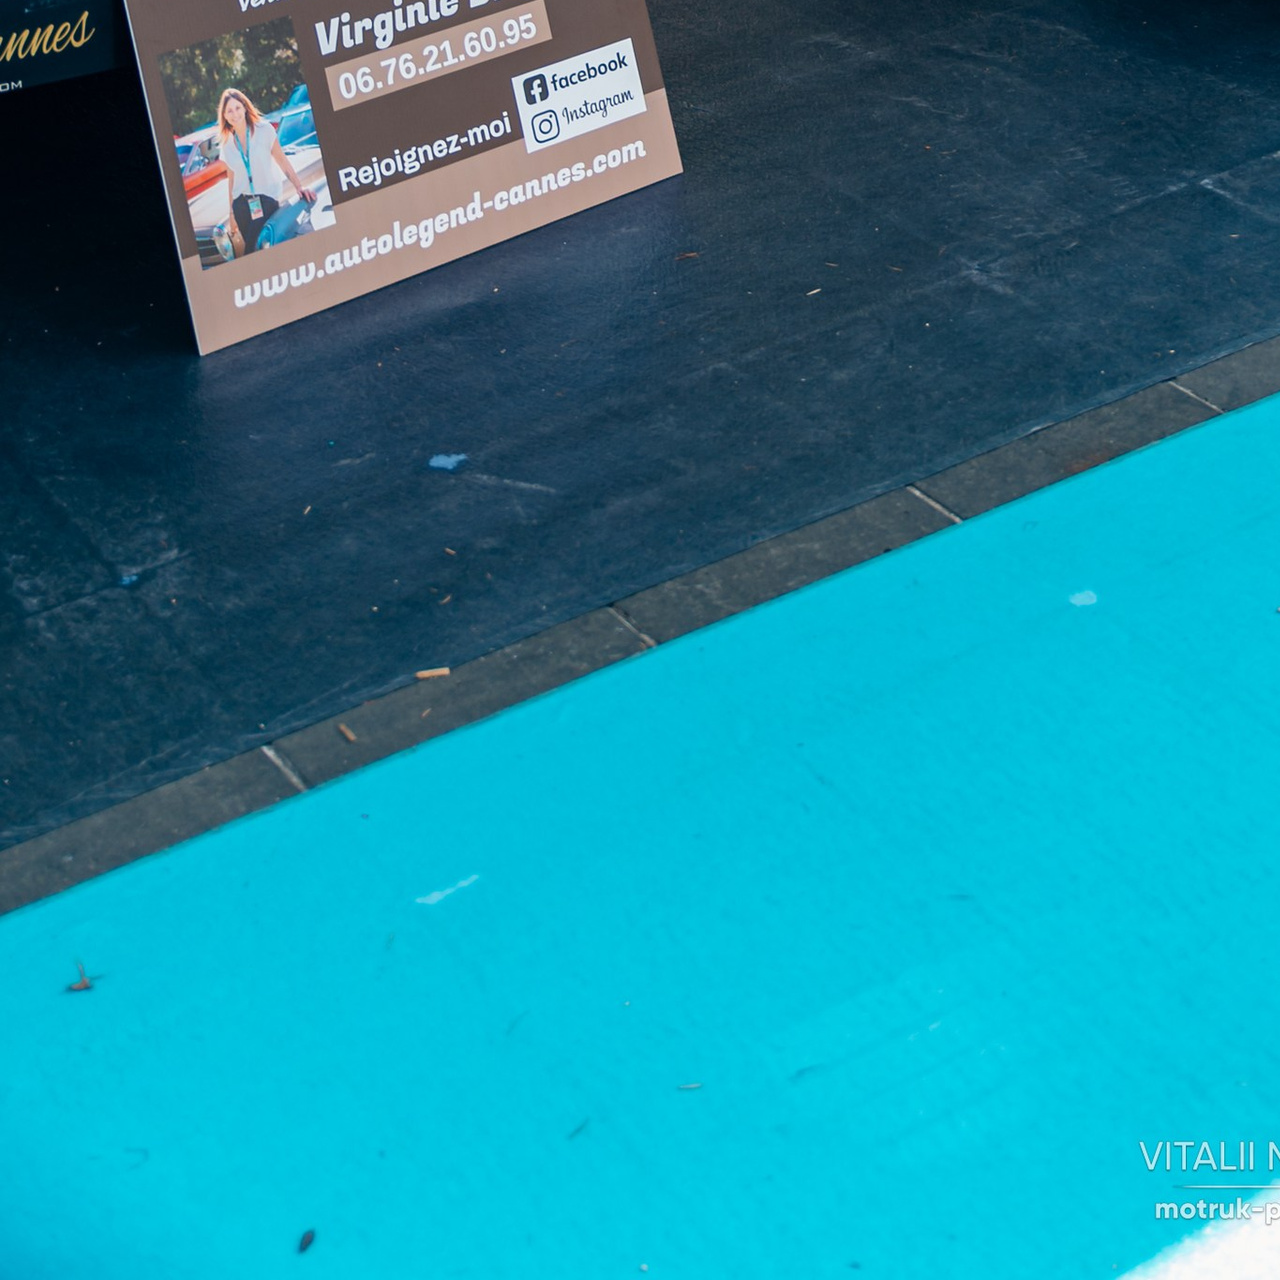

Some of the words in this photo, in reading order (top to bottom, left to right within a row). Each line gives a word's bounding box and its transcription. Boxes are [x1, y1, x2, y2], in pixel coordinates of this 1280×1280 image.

[338, 13, 537, 100] 06.76.21.60.95
[549, 53, 629, 93] facebook
[561, 87, 635, 126] Instagram
[338, 112, 512, 192] Rejoignez-moi
[233, 139, 647, 309] www.autolegend-cannes.com
